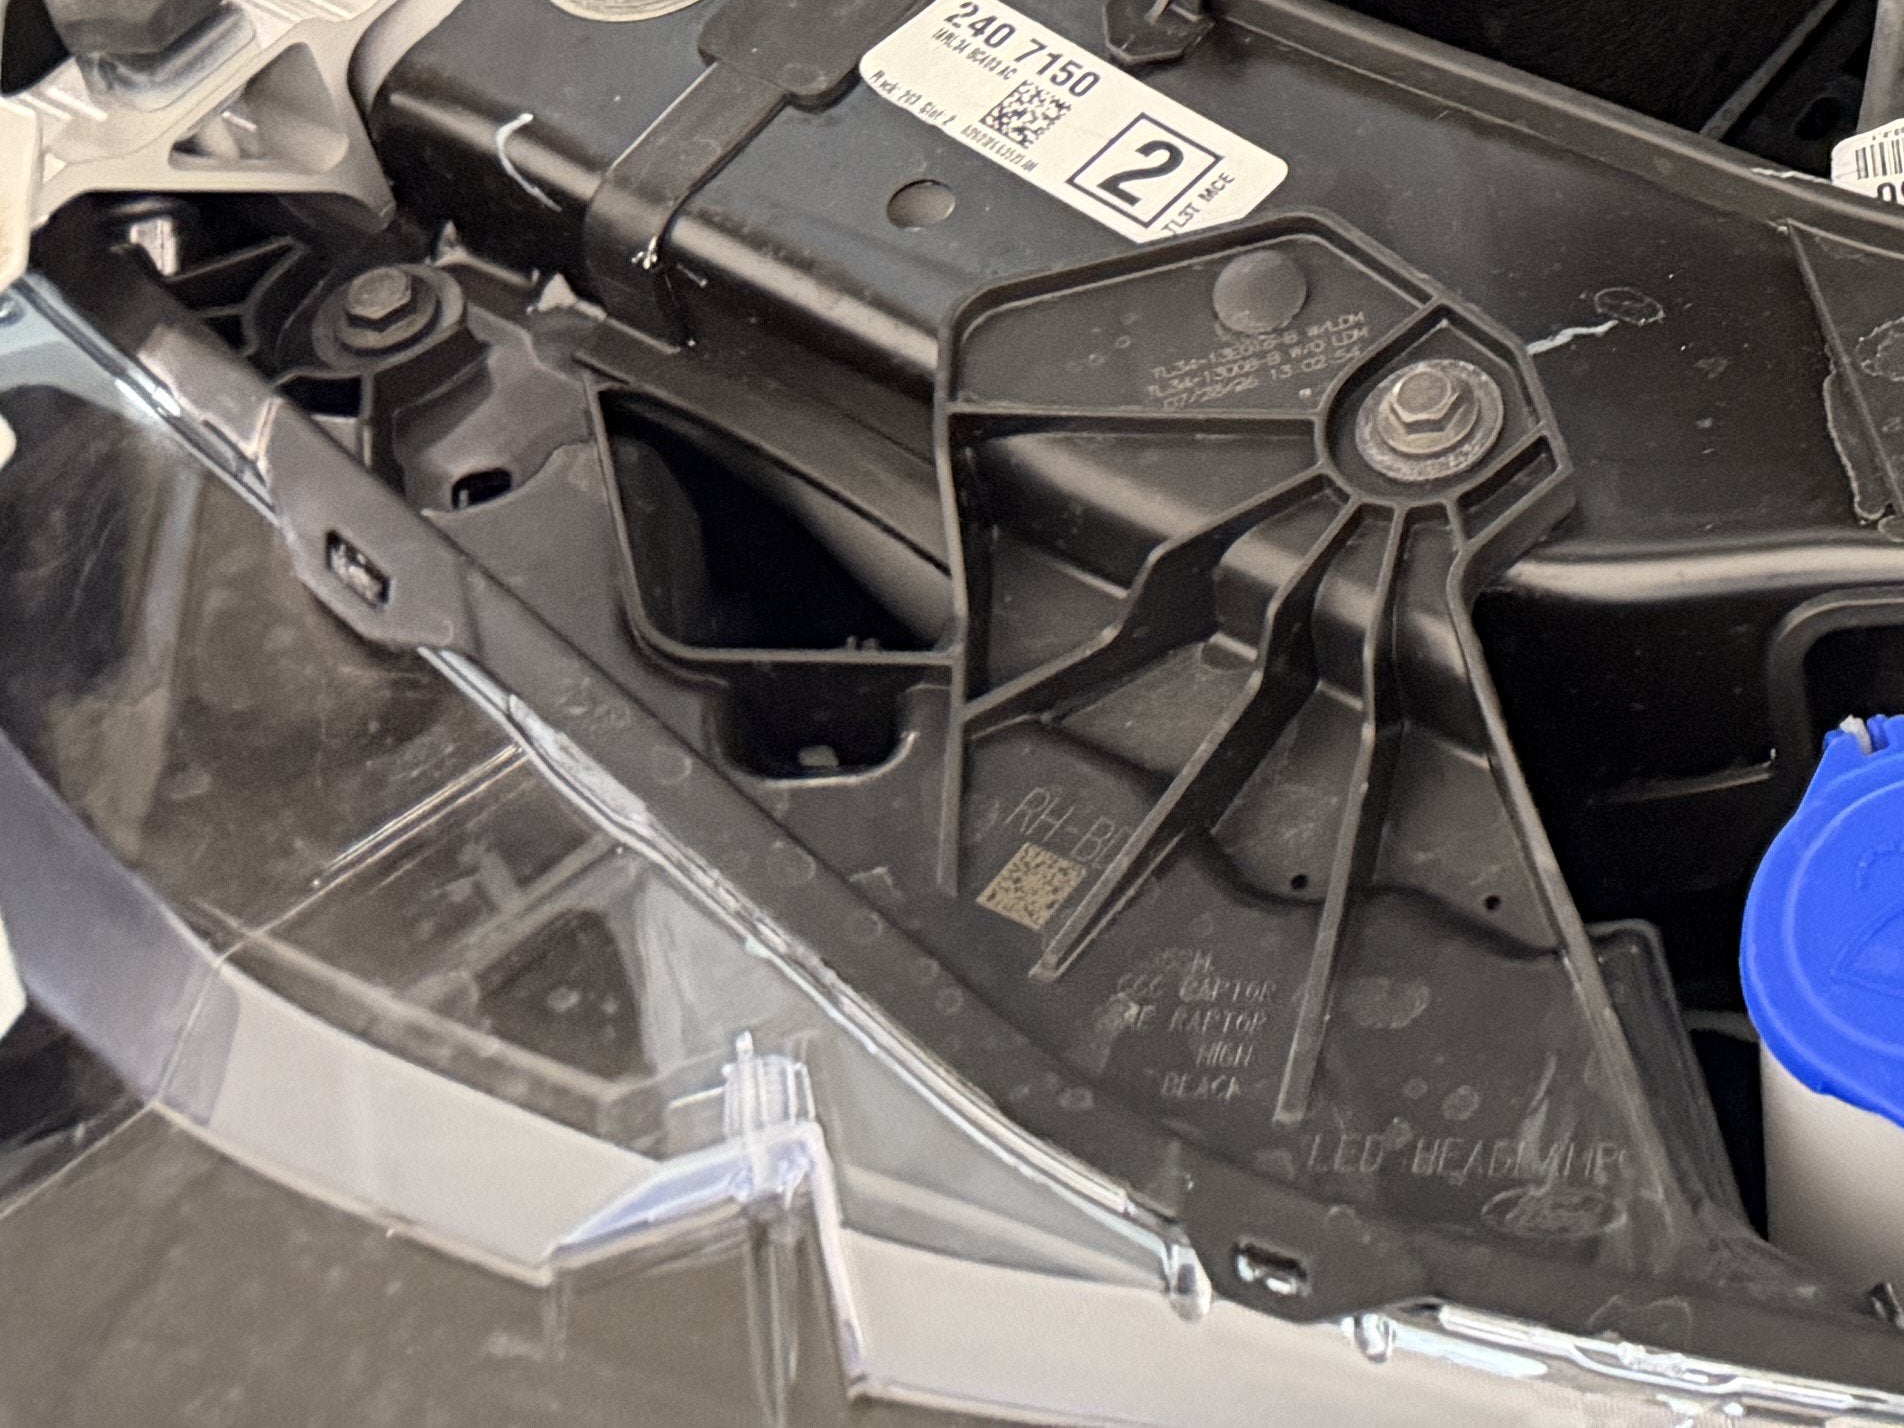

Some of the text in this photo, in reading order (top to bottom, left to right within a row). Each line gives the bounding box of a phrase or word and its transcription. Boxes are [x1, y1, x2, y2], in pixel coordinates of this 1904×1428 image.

[944, 1, 1101, 98] 240 7150
[1096, 139, 1185, 208] 2
